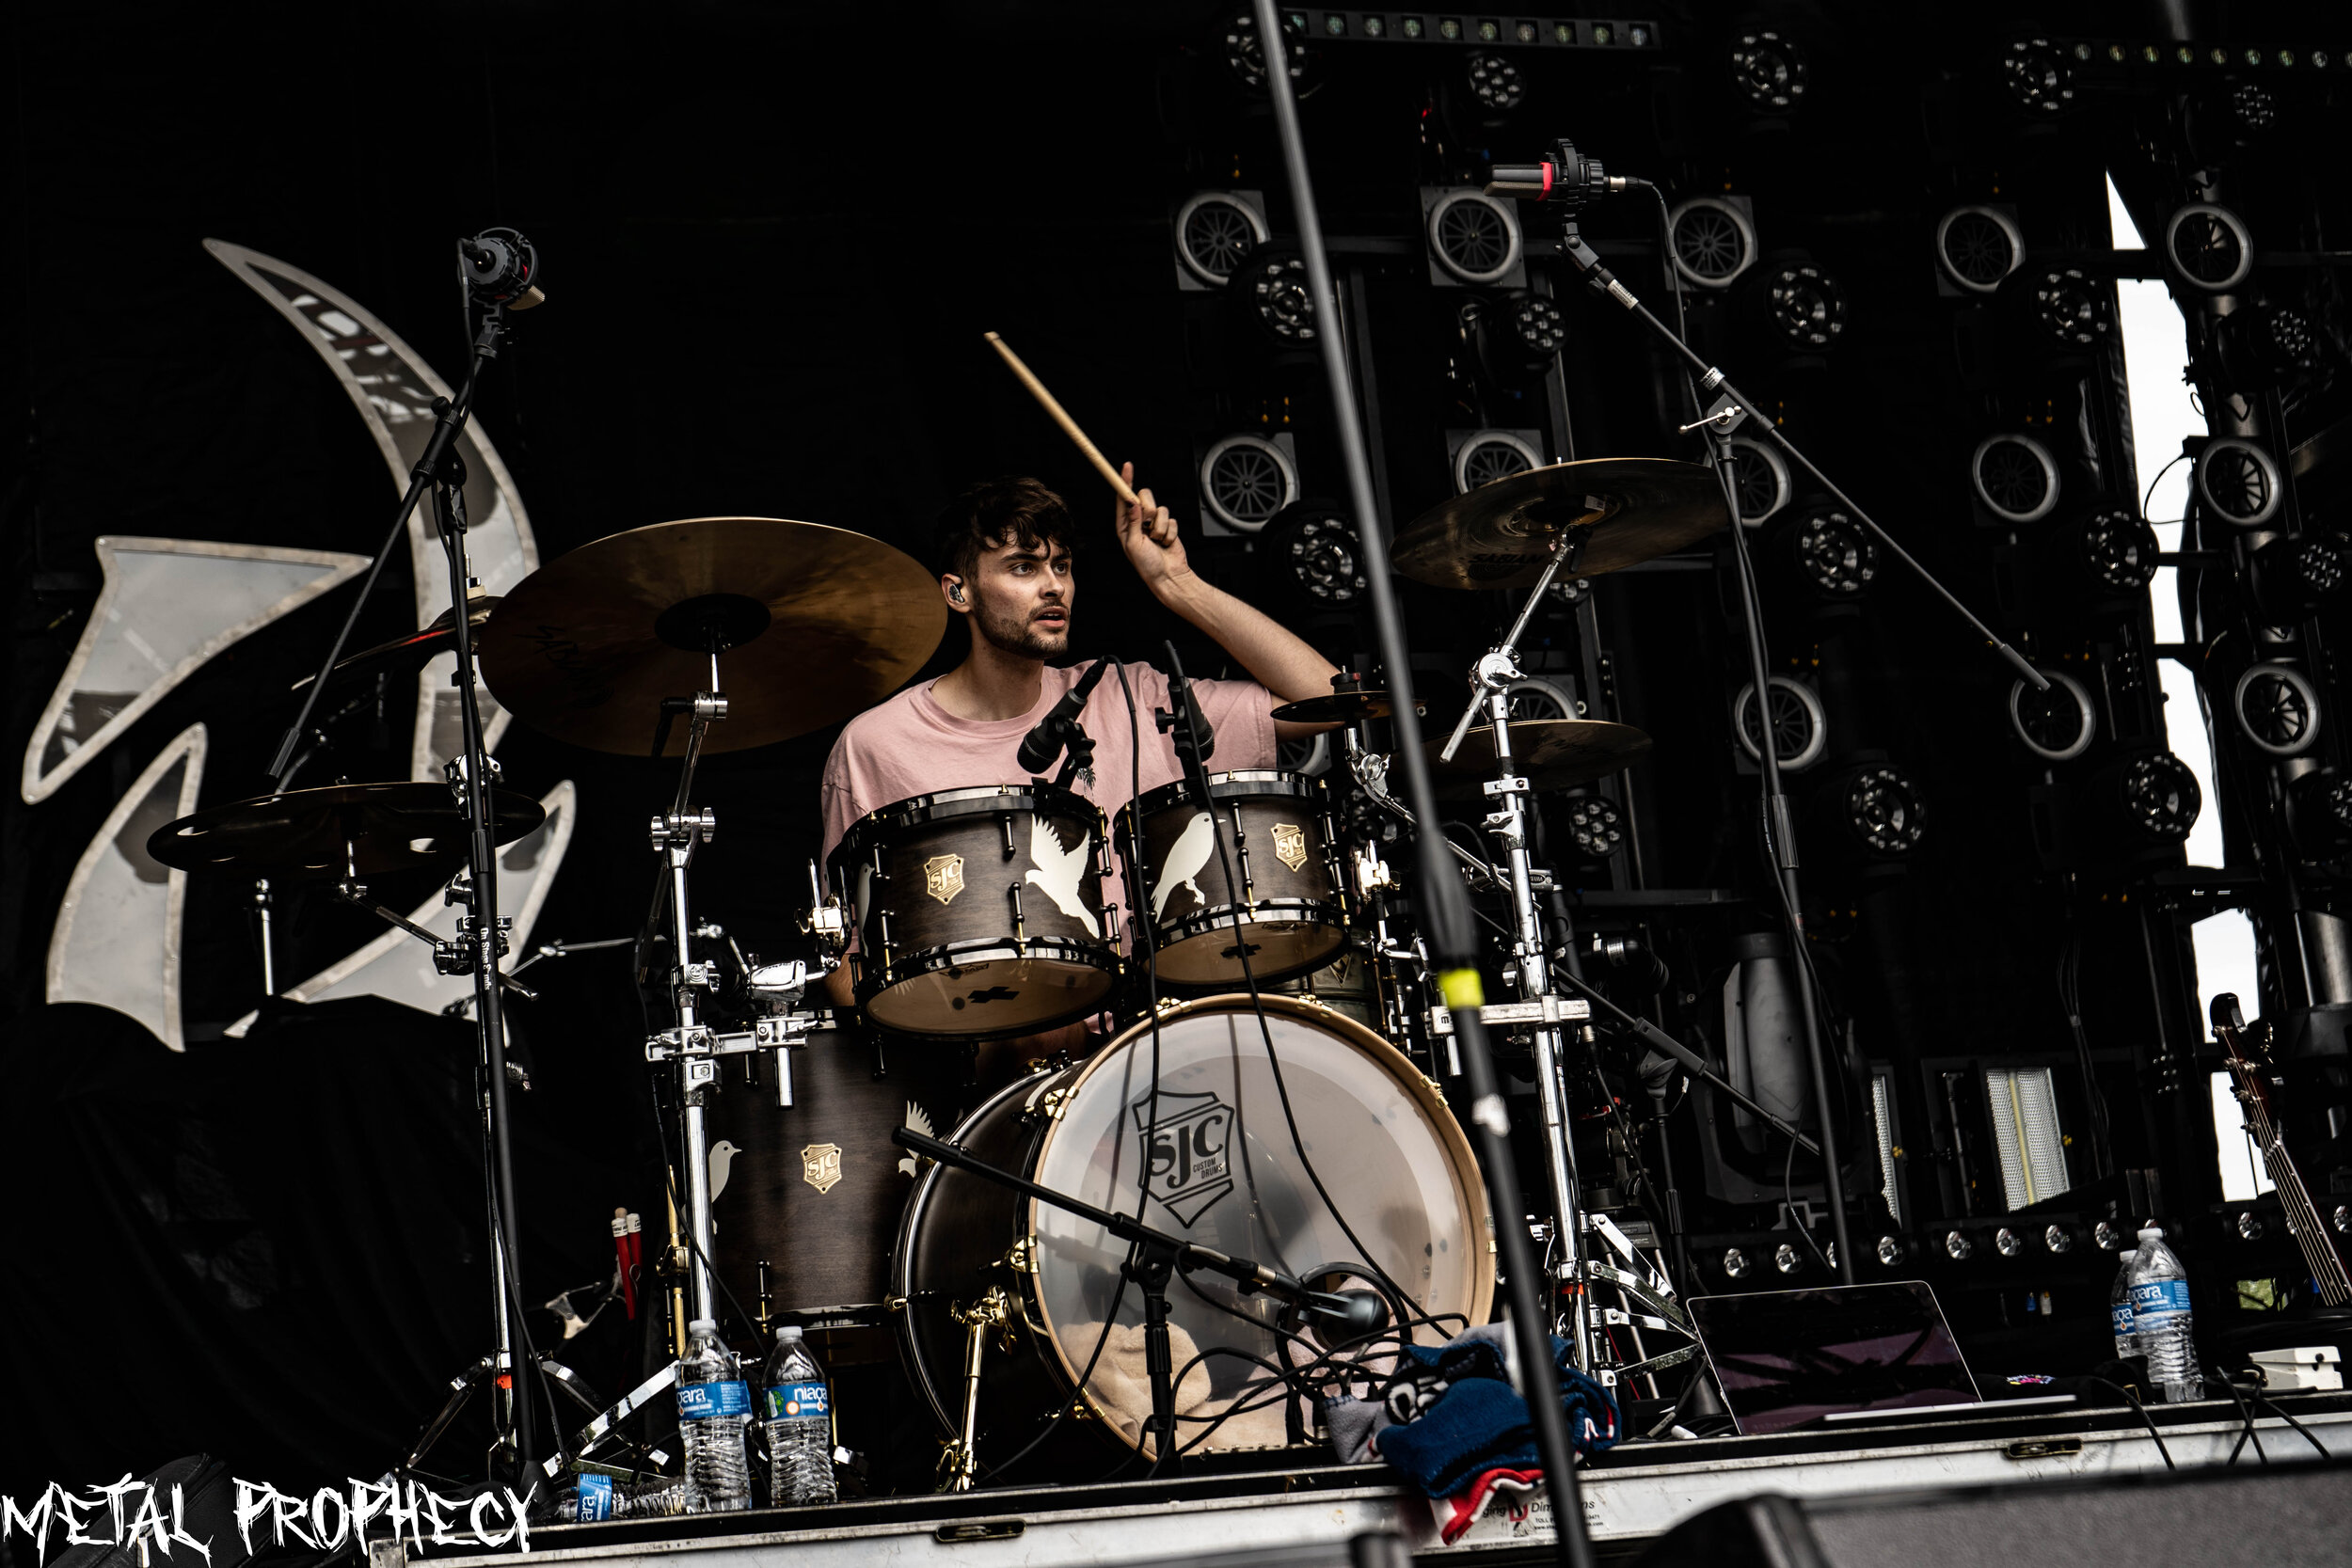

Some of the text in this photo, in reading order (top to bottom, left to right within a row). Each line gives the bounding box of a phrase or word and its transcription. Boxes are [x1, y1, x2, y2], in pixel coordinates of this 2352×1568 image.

[1468, 553, 1545, 564] SABIAN
[1279, 833, 1302, 858] SJC
[930, 862, 960, 892] SJC
[1151, 1115, 1223, 1189] SJC
[807, 1151, 837, 1180] SJC
[1193, 1157, 1216, 1173] CUSTOM
[1201, 1163, 1223, 1179] DRUMS
